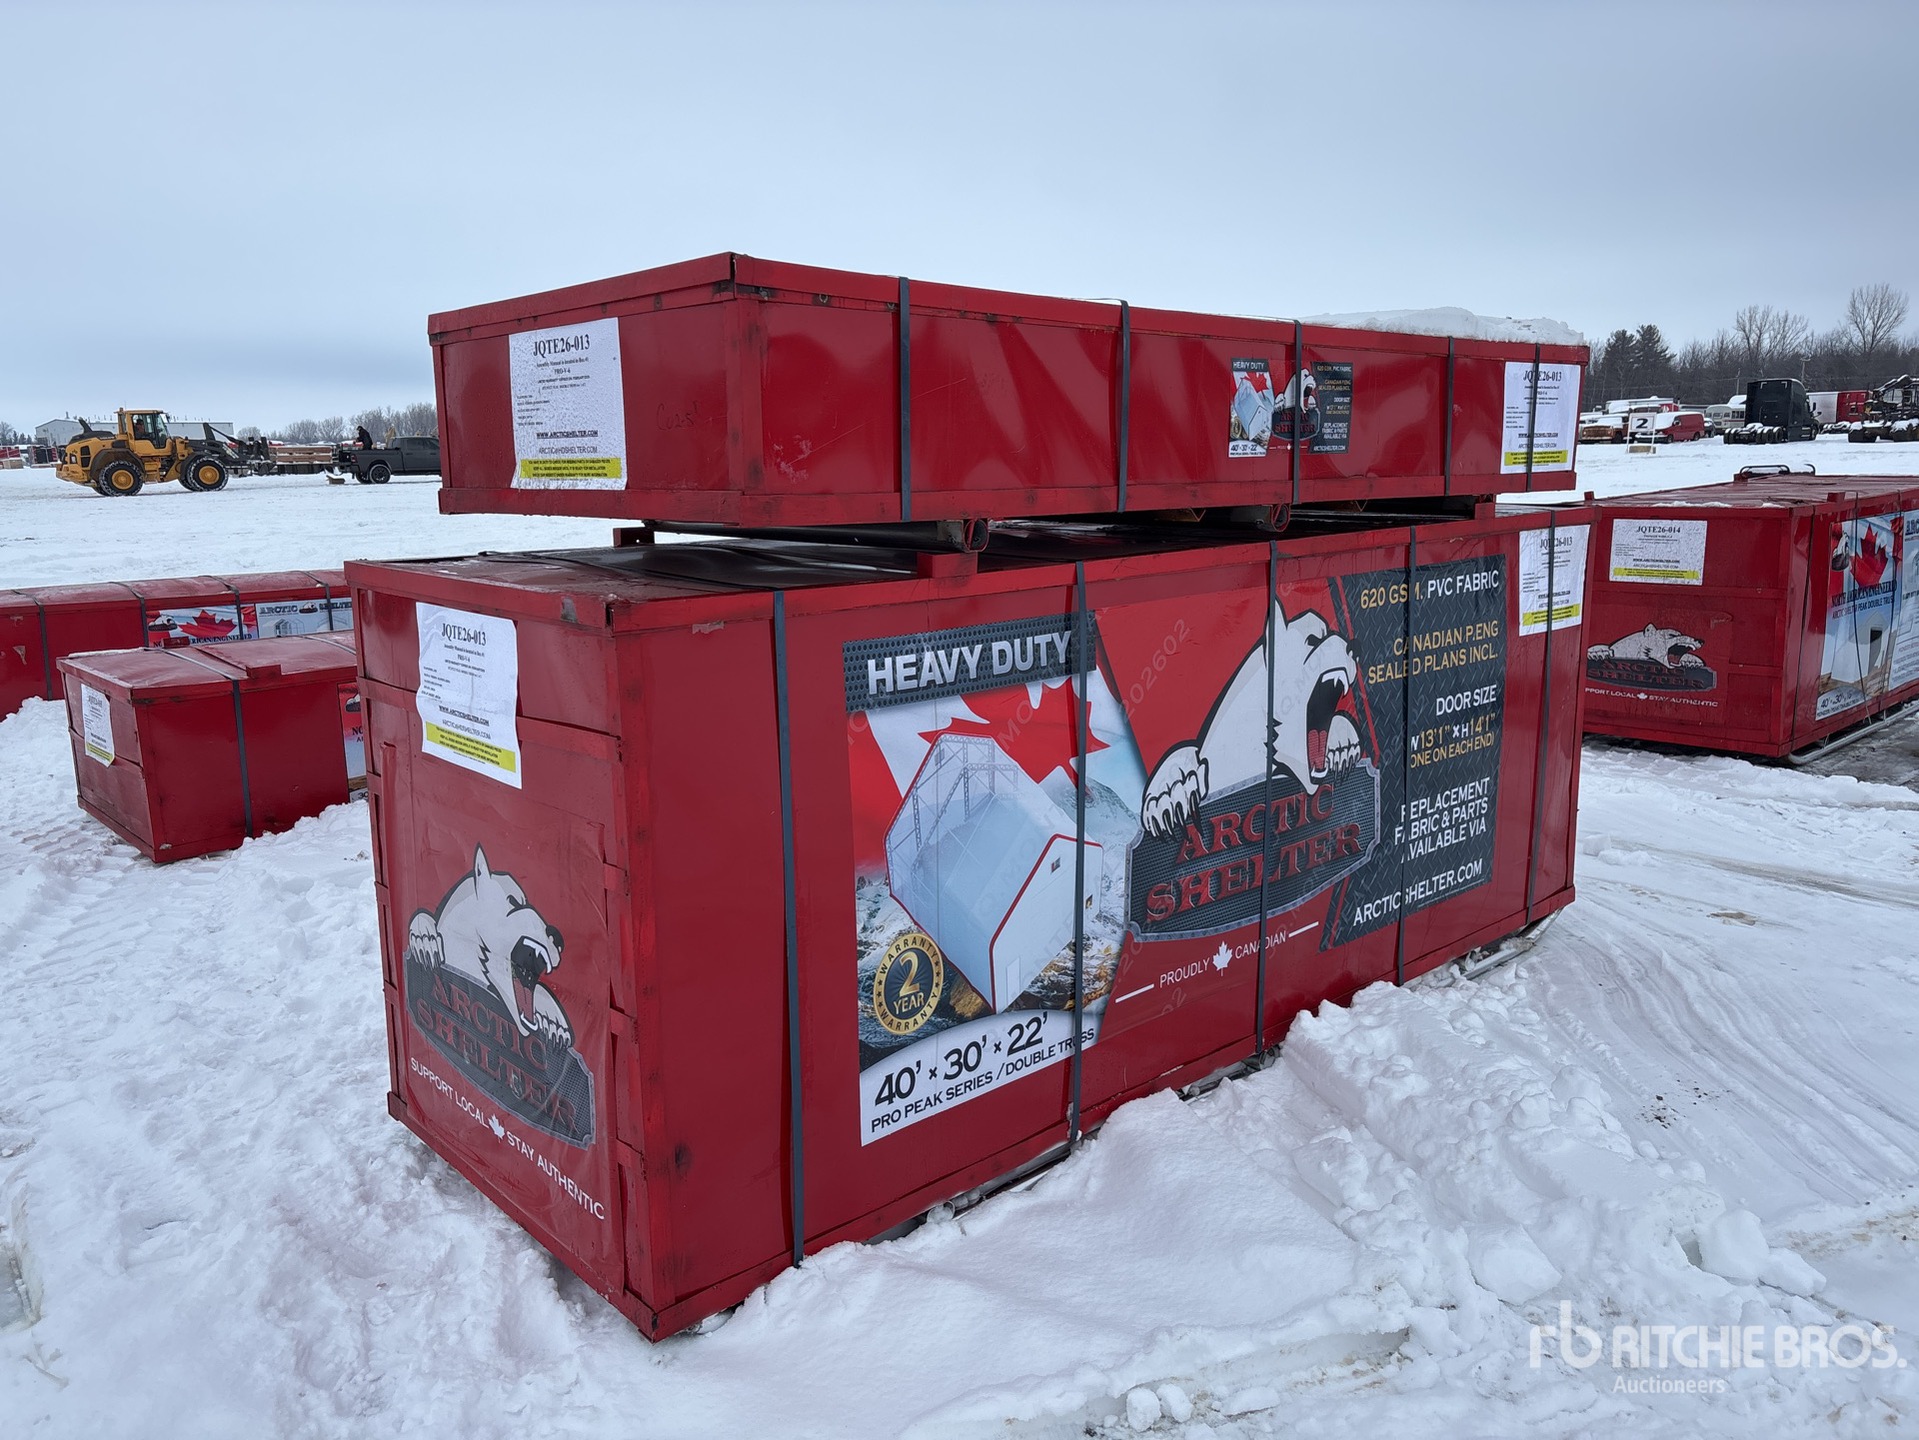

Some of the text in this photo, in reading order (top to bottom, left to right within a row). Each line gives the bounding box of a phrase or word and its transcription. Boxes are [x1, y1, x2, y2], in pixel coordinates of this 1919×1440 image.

[533, 334, 590, 358] JQTE26-013
[1233, 361, 1250, 369] HEAVY
[1523, 370, 1562, 383] JQE26-013
[1636, 418, 1648, 428] 2
[1636, 526, 1680, 534] JQTE26-014
[1360, 587, 1386, 609] 620
[1427, 577, 1453, 598] PVC
[1456, 570, 1499, 594] FABRIC
[259, 605, 298, 614] ARCTIC
[442, 622, 486, 646] JQTE26-013
[1465, 620, 1499, 642] P.ENG
[867, 630, 1072, 696] HEAVY DUTY
[1368, 642, 1498, 685] SEALED PLANS INCL.
[1588, 668, 1704, 688] SHELTER
[1602, 660, 1686, 674] ARCTIC
[1436, 684, 1498, 716] DOOR SIZE
[1611, 690, 1636, 698] LOCAL
[1670, 698, 1718, 708] AUTHENTIC
[1432, 746, 1447, 762] ON
[1448, 738, 1474, 758] EACH
[1474, 732, 1495, 750] END)
[1176, 783, 1335, 863] ARCTIC
[1442, 811, 1450, 828] &
[1452, 797, 1488, 824] PARTS
[1469, 816, 1487, 837] VIA
[1145, 822, 1363, 924] SHELTER
[880, 936, 938, 976] WARRANTY
[899, 951, 920, 996] 2
[1159, 957, 1211, 988] PROUDLY
[880, 992, 938, 1031] WARRANTY
[893, 992, 924, 1015] YEAR
[430, 972, 549, 1072] ARCTIC
[416, 998, 579, 1136] SHELTER
[874, 1060, 922, 1107] 40'
[943, 1034, 988, 1082] 30'
[1006, 1011, 1048, 1058] 22'
[871, 1109, 901, 1133] PRO
[904, 1090, 943, 1120] PEAK
[946, 1072, 993, 1101] SERIES
[1057, 1028, 1095, 1054] TRSS
[410, 1058, 606, 1221] SUPPORT LOCAL STAY AUTHENTIC
